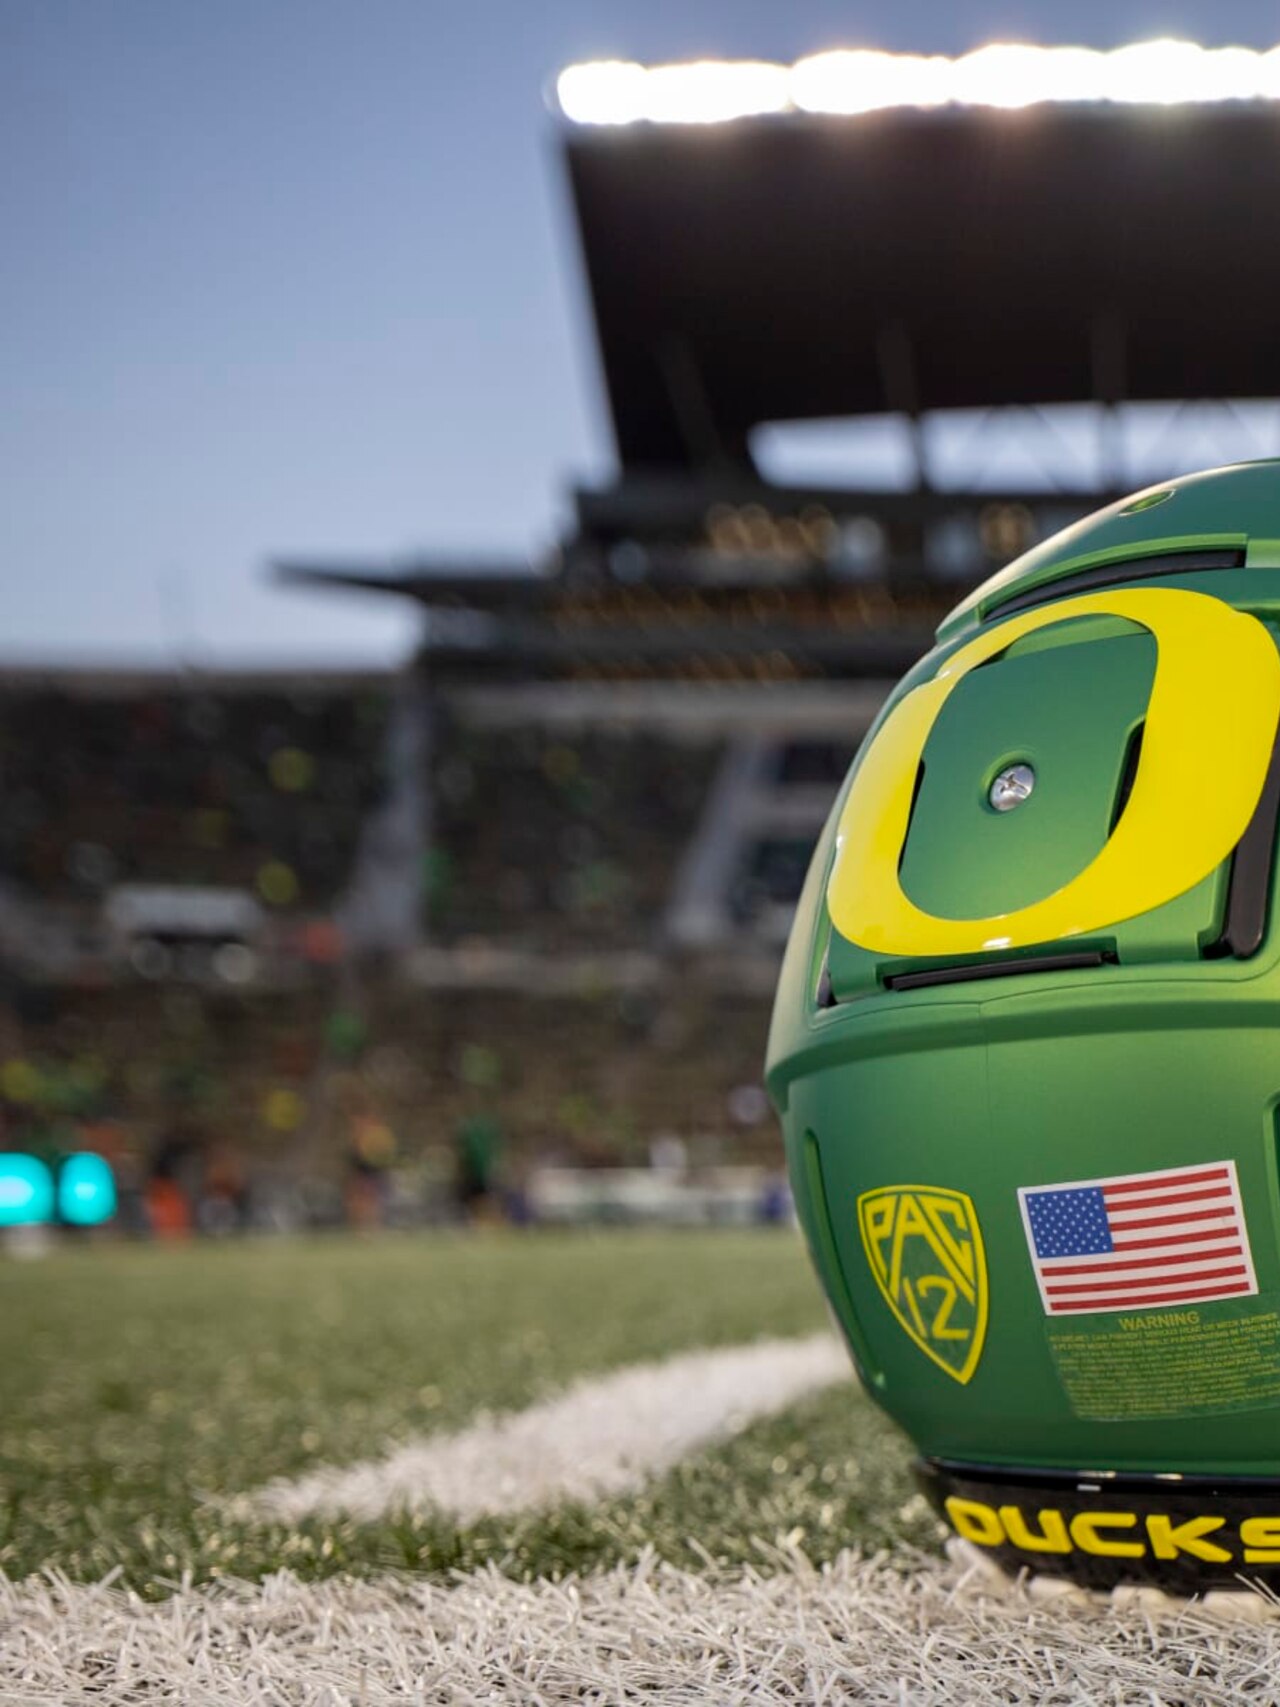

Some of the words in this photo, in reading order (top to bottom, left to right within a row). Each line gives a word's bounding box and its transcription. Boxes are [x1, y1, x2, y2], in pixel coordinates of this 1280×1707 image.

[864, 1194, 977, 1306] PAC
[903, 1274, 970, 1340] 12
[1118, 1311, 1200, 1331] WARNING
